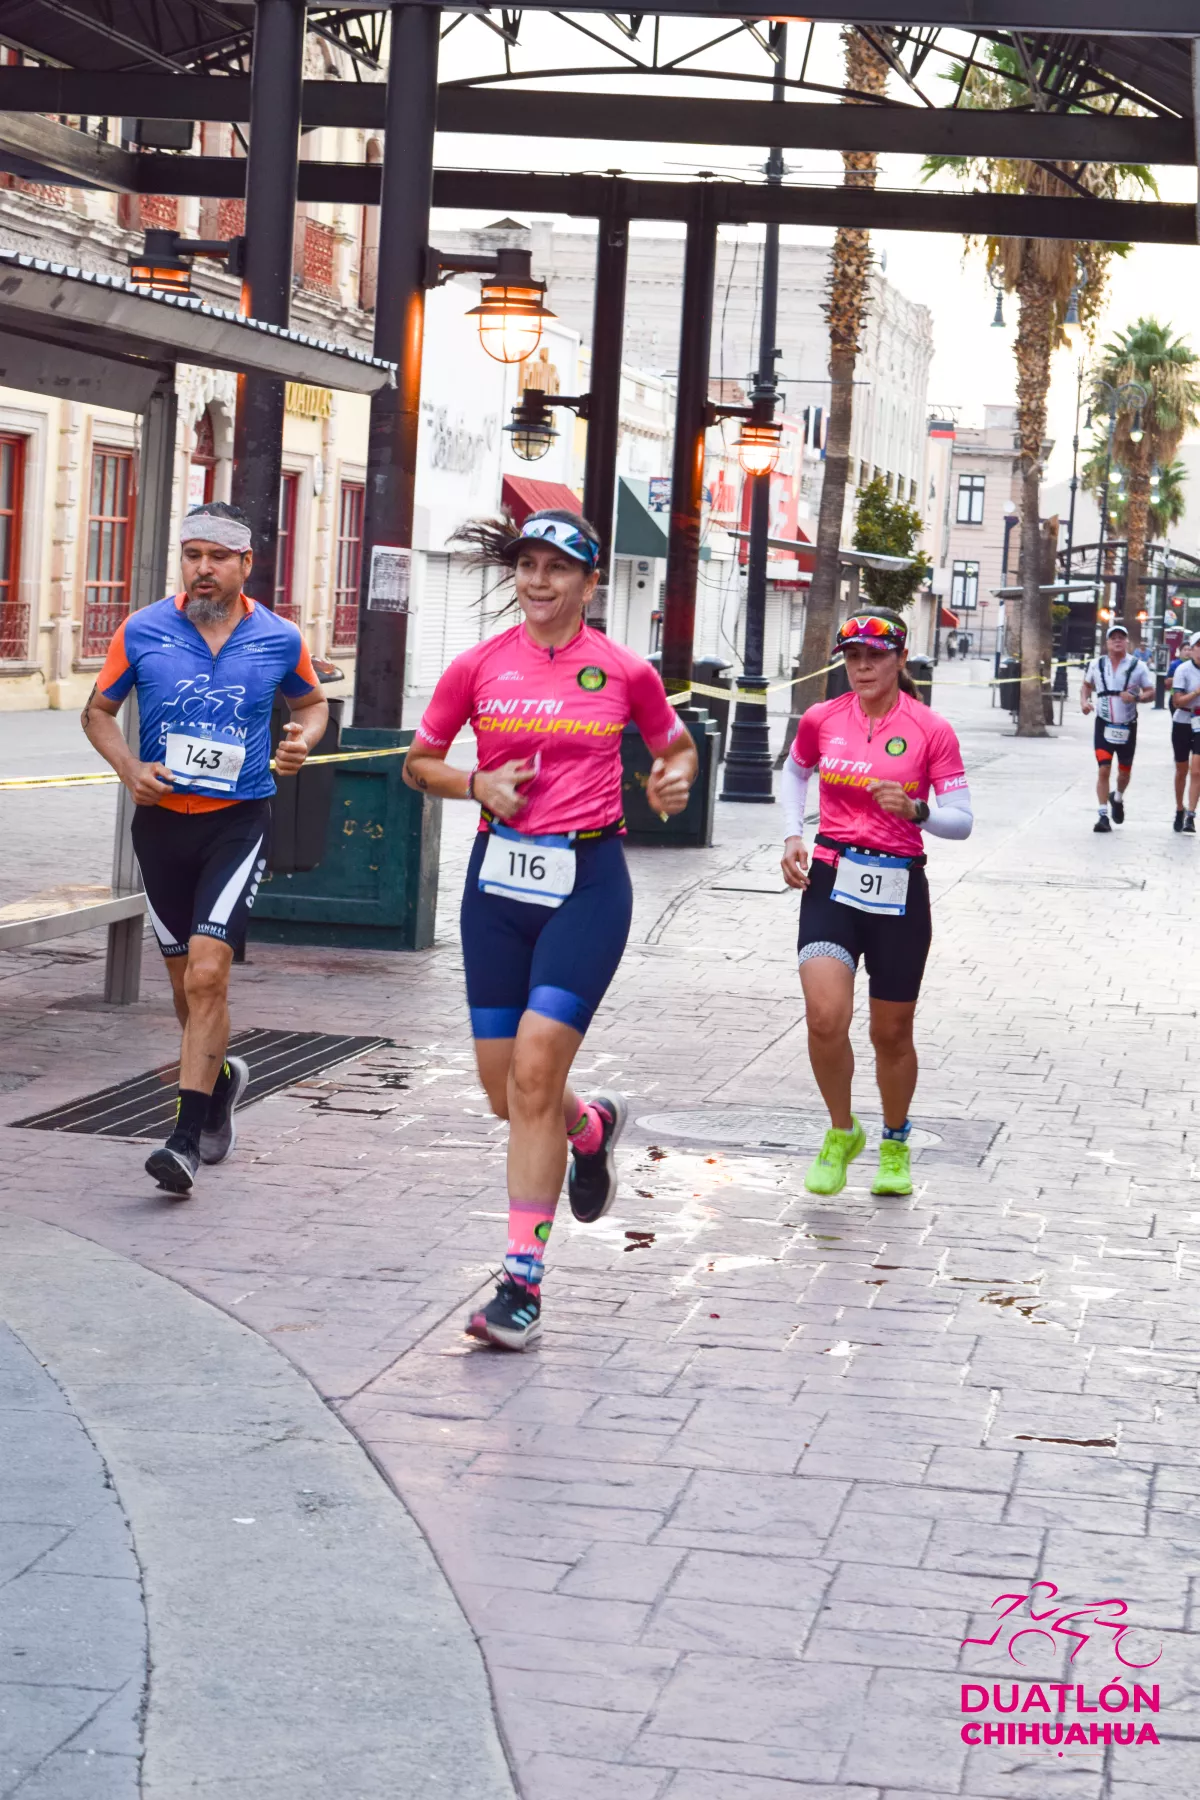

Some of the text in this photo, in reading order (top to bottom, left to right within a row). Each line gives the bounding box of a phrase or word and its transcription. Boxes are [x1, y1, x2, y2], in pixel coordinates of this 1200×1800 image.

[477, 698, 564, 716] UNITRI
[479, 716, 625, 737] CHIHUAHUA
[186, 744, 223, 770] 143
[820, 756, 872, 774] NITRI
[508, 851, 546, 880] 116
[860, 874, 883, 896] 91
